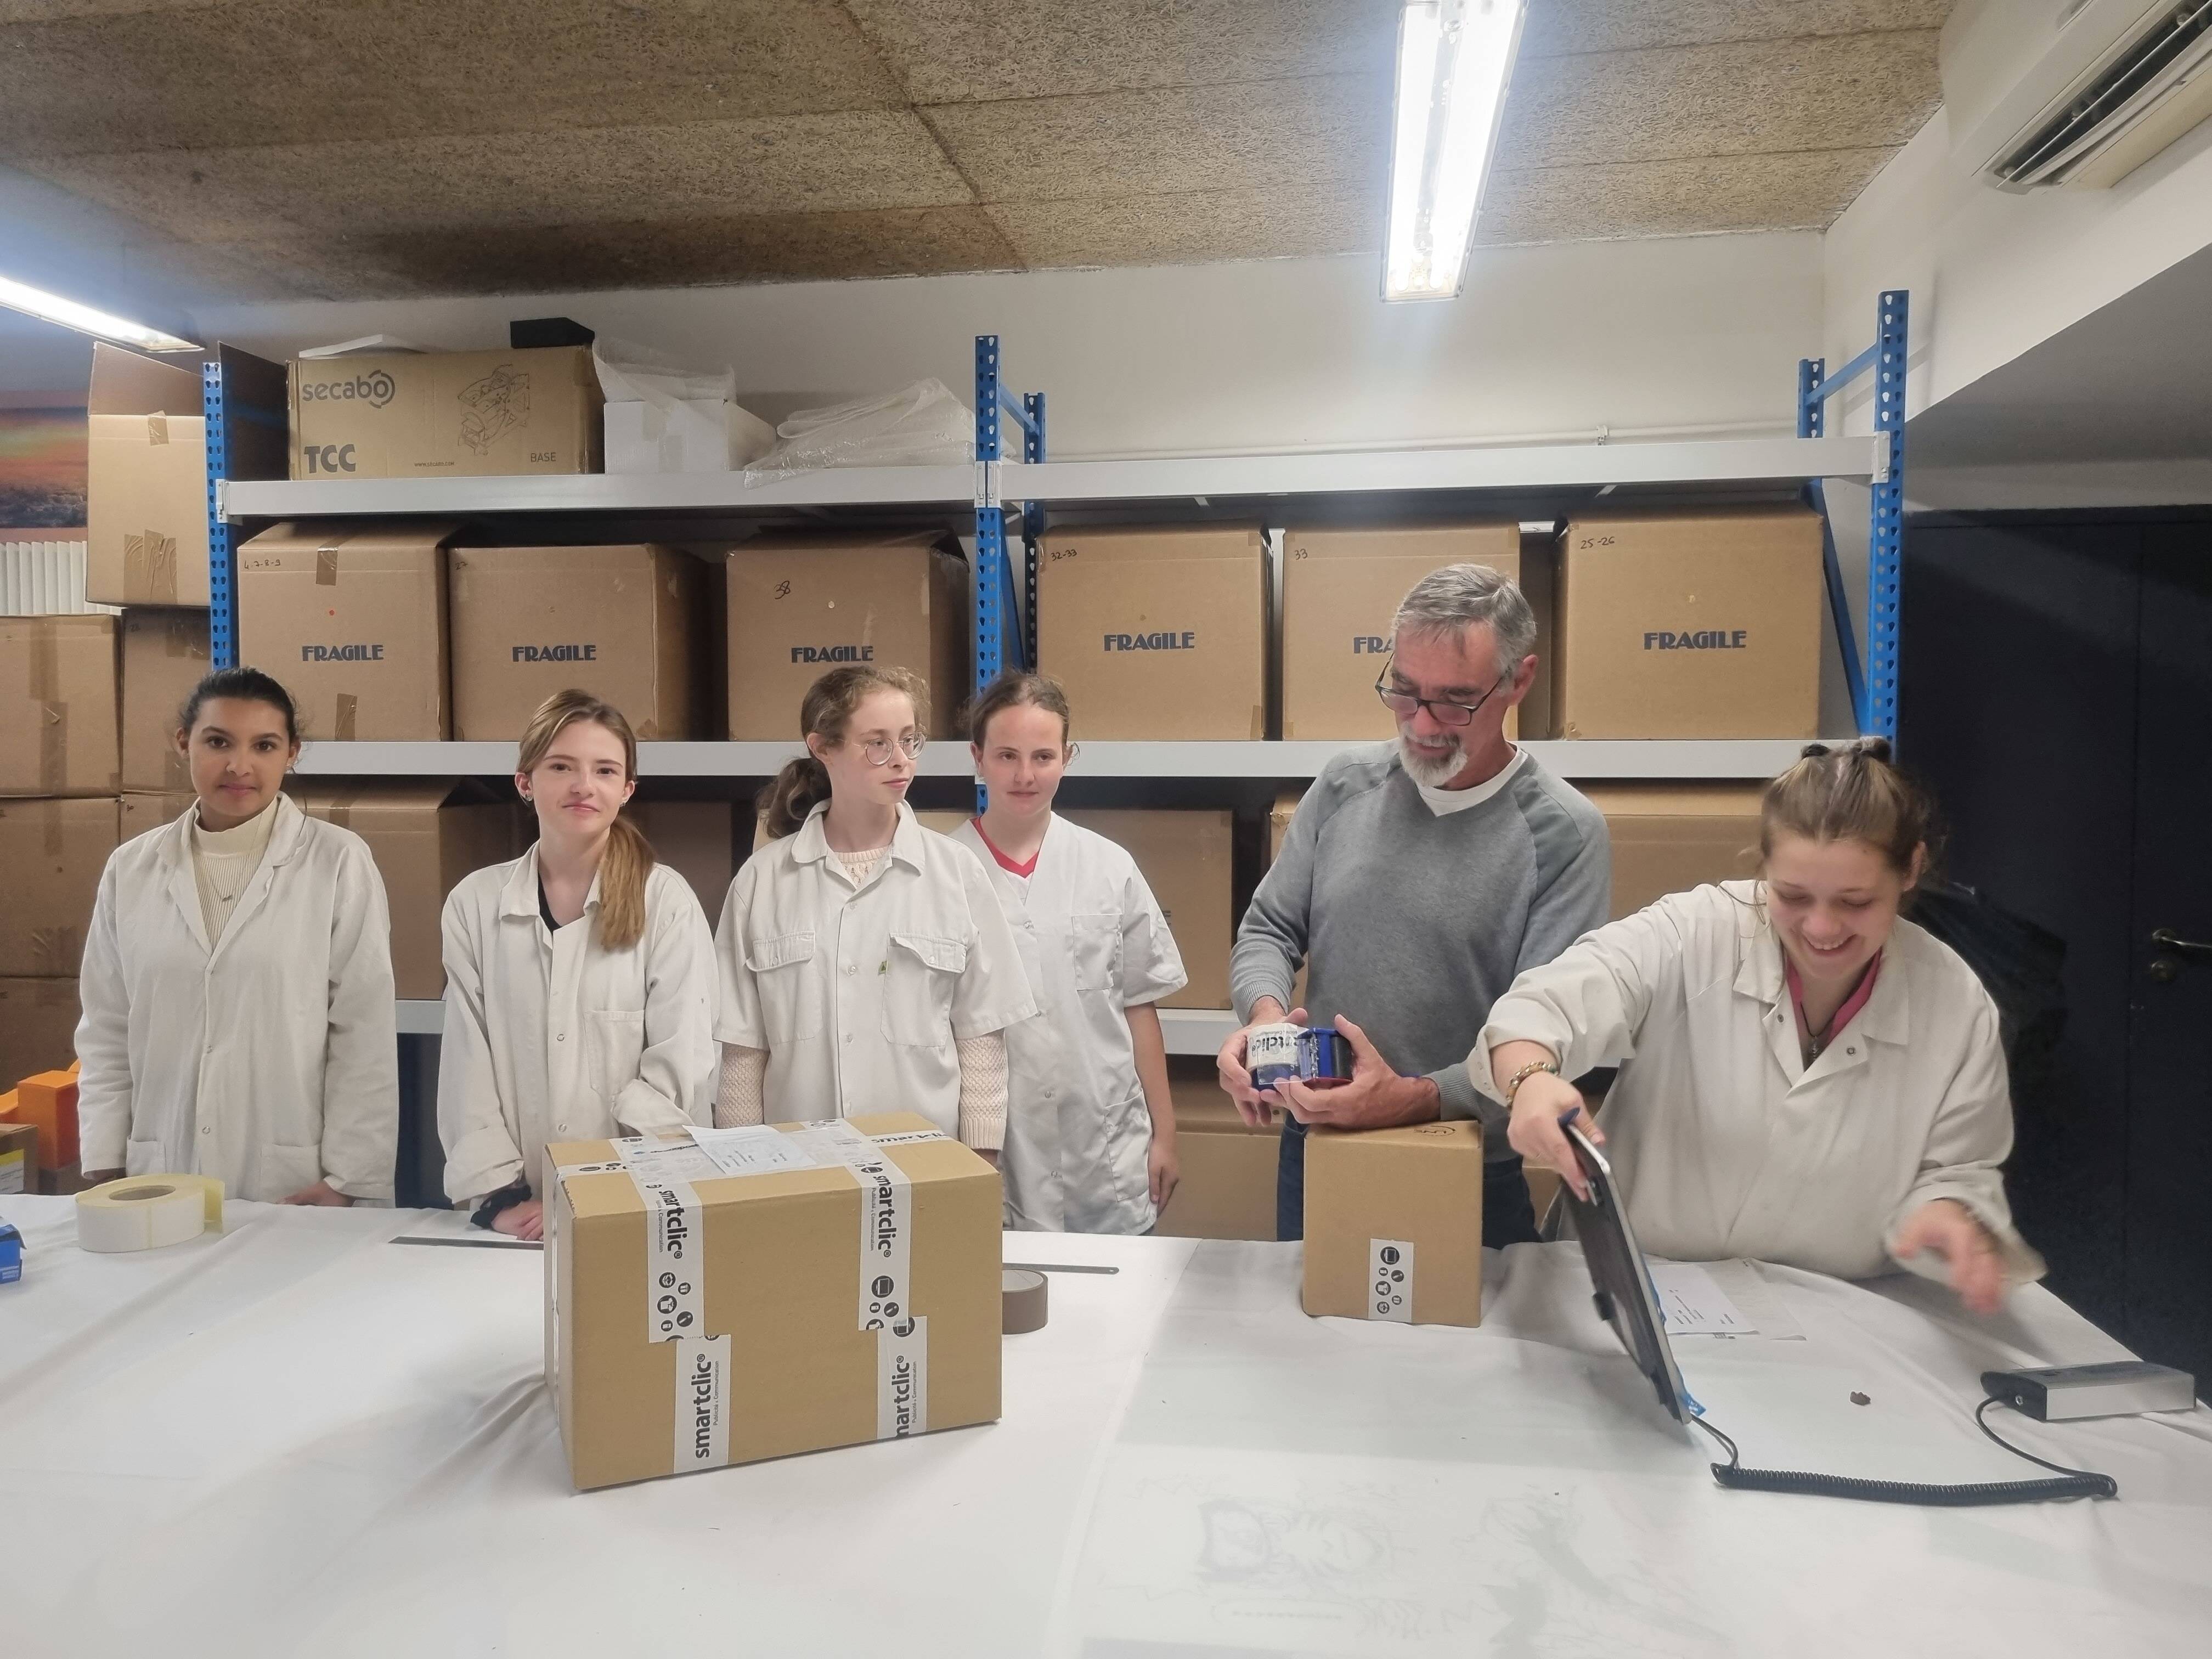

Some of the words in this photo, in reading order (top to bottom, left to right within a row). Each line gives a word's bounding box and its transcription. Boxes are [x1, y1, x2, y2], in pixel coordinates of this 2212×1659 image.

[302, 371, 396, 406] secabo
[304, 444, 356, 473] TCC
[531, 452, 556, 463] BASE
[1581, 536, 1615, 549] 25-26
[1051, 549, 1077, 562] 32-33
[1294, 549, 1308, 561] 33
[1104, 631, 1195, 652] FRAGILE
[1643, 630, 1747, 651] FRAGILE
[301, 644, 384, 662] FRAGILE
[512, 645, 597, 662] FRAGILE
[791, 645, 873, 663] FRAGILE
